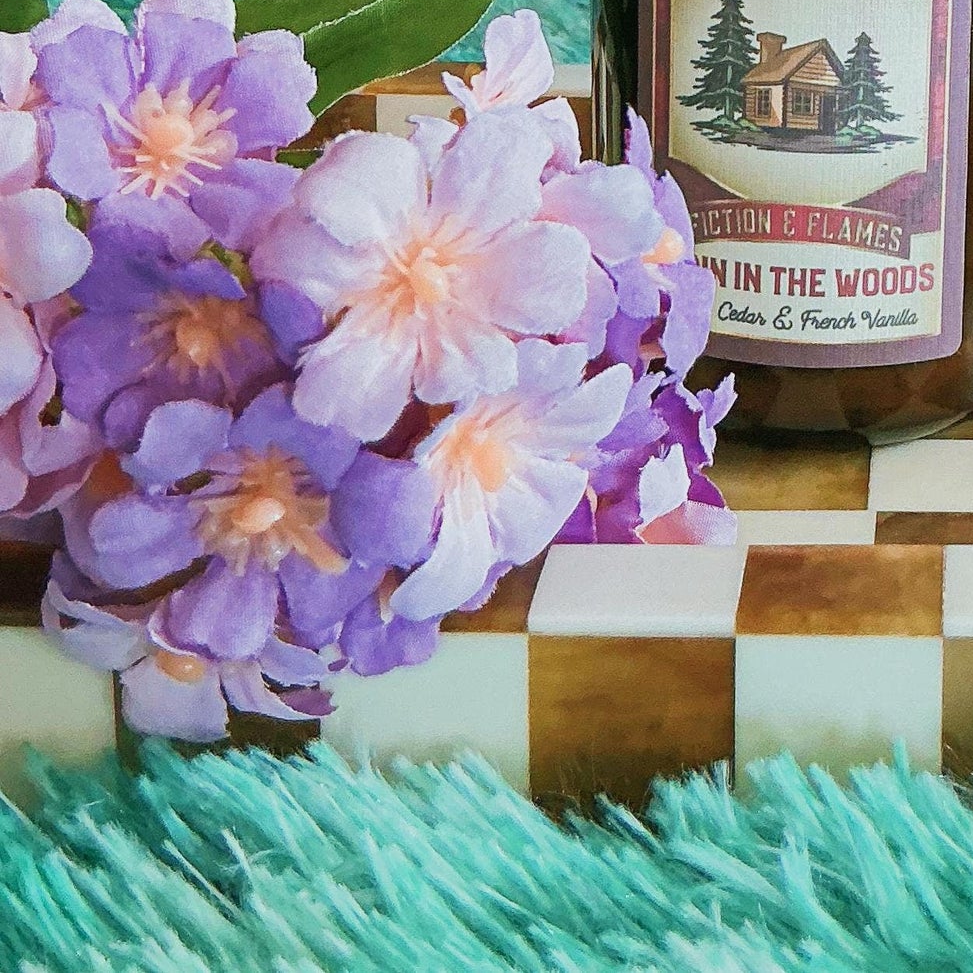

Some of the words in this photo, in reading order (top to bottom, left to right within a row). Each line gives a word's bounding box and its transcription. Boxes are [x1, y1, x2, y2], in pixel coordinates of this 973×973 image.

[807, 211, 903, 253] FLAMES
[734, 261, 762, 294] IN
[769, 266, 827, 298] THE
[835, 262, 936, 298] WOODS
[717, 301, 767, 327] Cedar
[772, 306, 794, 331] &
[800, 309, 858, 331] French
[861, 308, 920, 329] Vanilla
